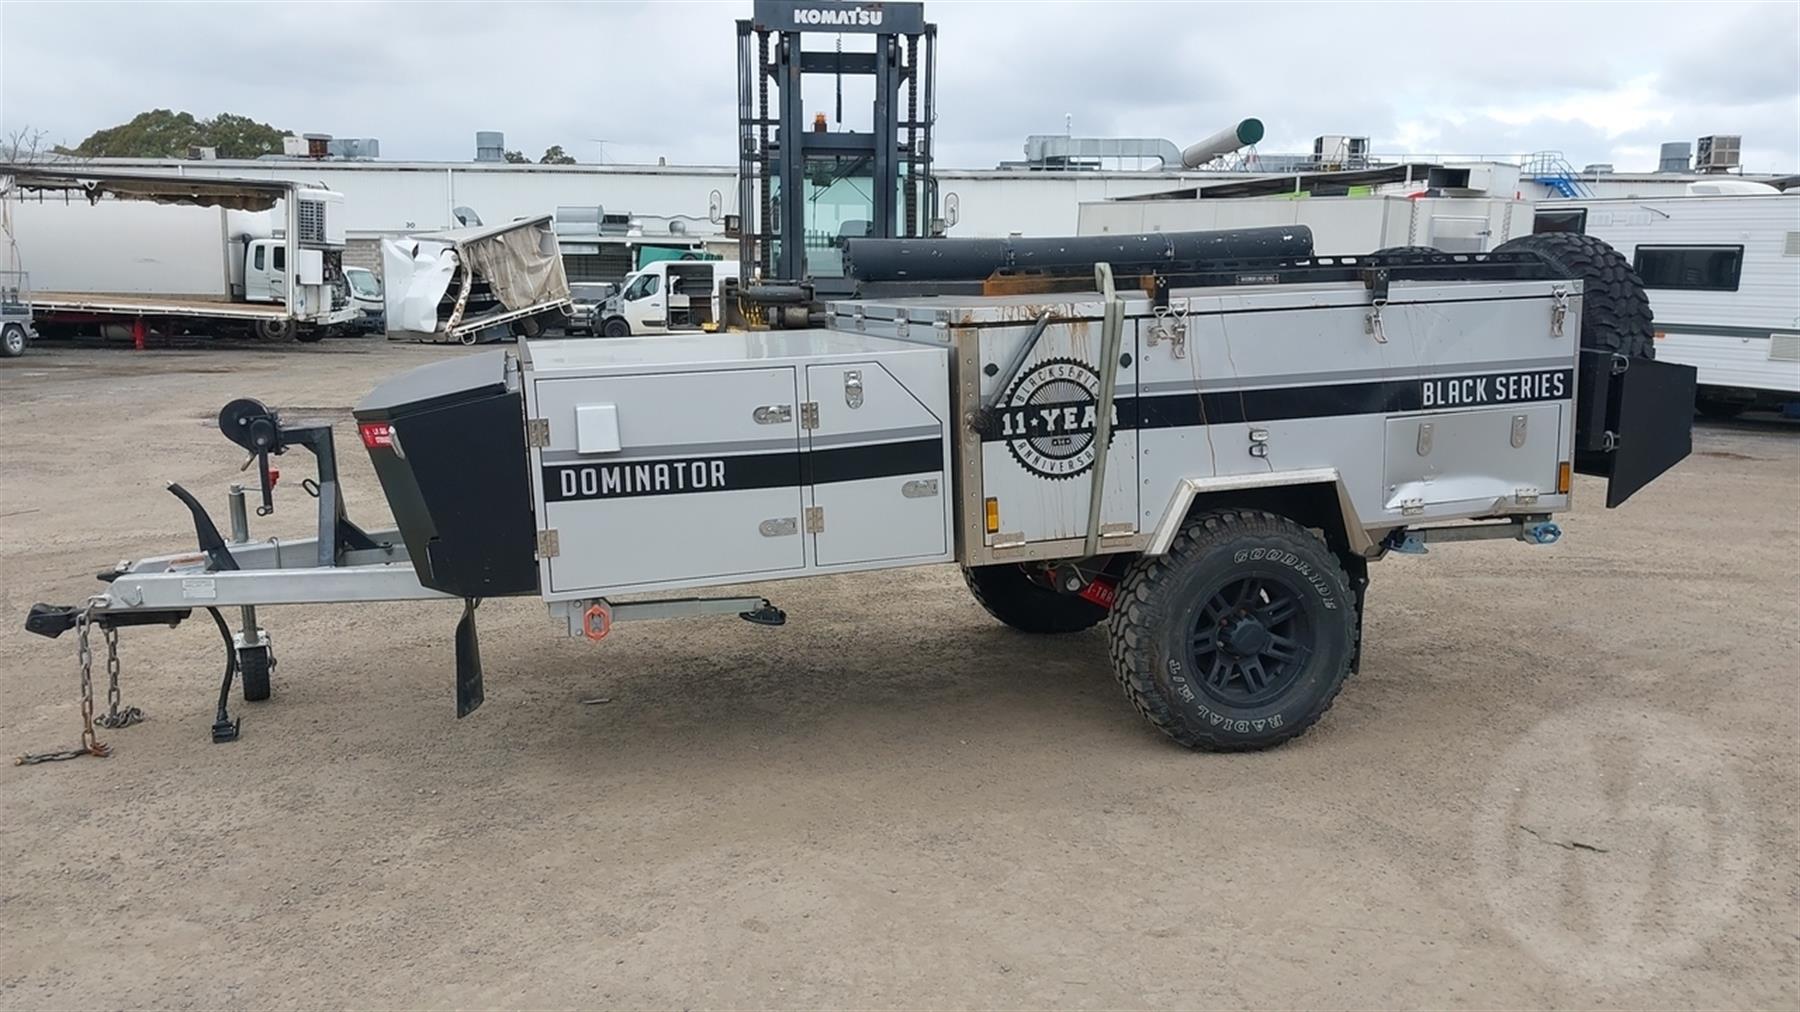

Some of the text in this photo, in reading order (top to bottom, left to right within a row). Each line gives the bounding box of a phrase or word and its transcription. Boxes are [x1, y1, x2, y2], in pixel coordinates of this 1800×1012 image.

[794, 8, 882, 25] KOMATSU
[1422, 372, 1564, 407] BLACK SERIES
[1002, 411, 1027, 436] 11
[1017, 440, 1097, 472] ANNIVERSA
[560, 460, 726, 497] DOMINATOR
[1234, 547, 1338, 610] GOODRIDE
[1197, 704, 1284, 733] RADIAL
